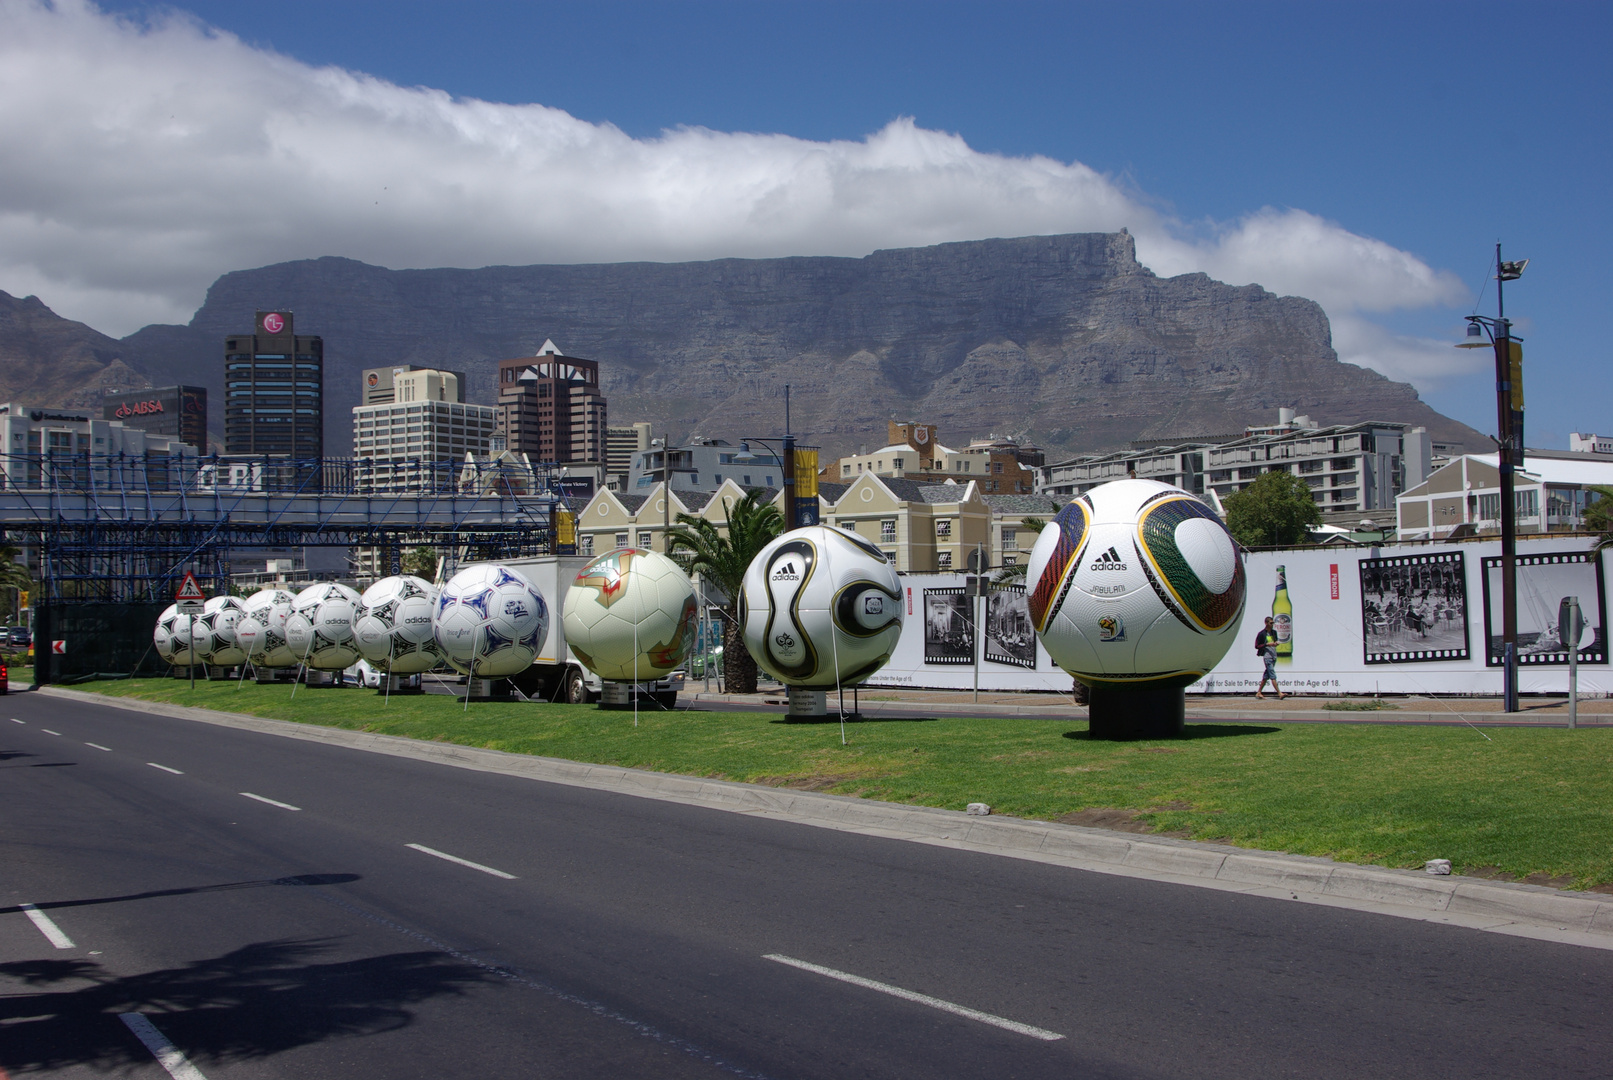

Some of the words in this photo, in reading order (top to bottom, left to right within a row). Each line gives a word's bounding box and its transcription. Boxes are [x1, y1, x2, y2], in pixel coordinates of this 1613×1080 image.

[132, 399, 164, 415] ABSA
[1090, 562, 1128, 571] adidas
[772, 573, 800, 581] adidas
[1089, 585, 1126, 594] JABULANI
[404, 616, 432, 624] adidas
[1306, 680, 1321, 689] Age
